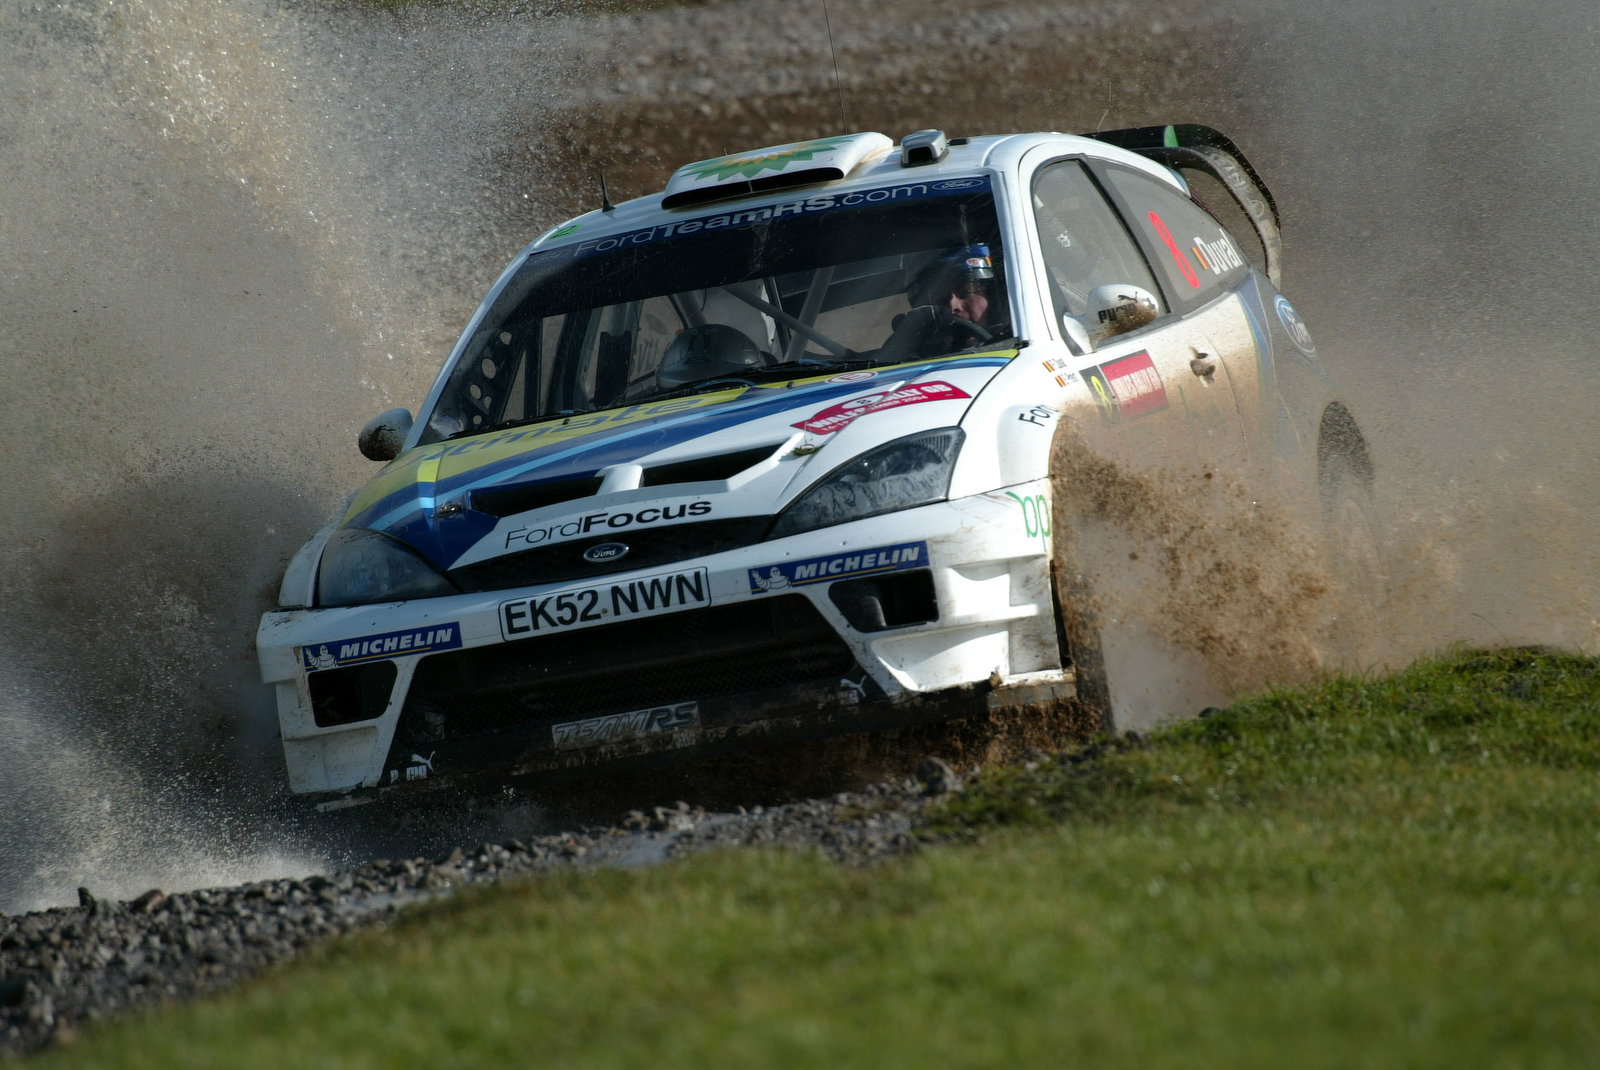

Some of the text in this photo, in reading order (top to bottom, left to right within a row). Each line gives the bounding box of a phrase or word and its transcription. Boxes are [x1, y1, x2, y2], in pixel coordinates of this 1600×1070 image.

[573, 182, 928, 257] FordTeamRS.com
[1148, 211, 1200, 288] 8
[1193, 228, 1243, 275] Duval
[1090, 375, 1114, 417] 8
[504, 501, 713, 549] FordFocus
[1004, 491, 1052, 552] bp
[794, 547, 920, 580] MICHELIN
[504, 571, 705, 635] EK52 NWN
[339, 628, 453, 659] MICHELIN
[390, 764, 428, 785] PMA
